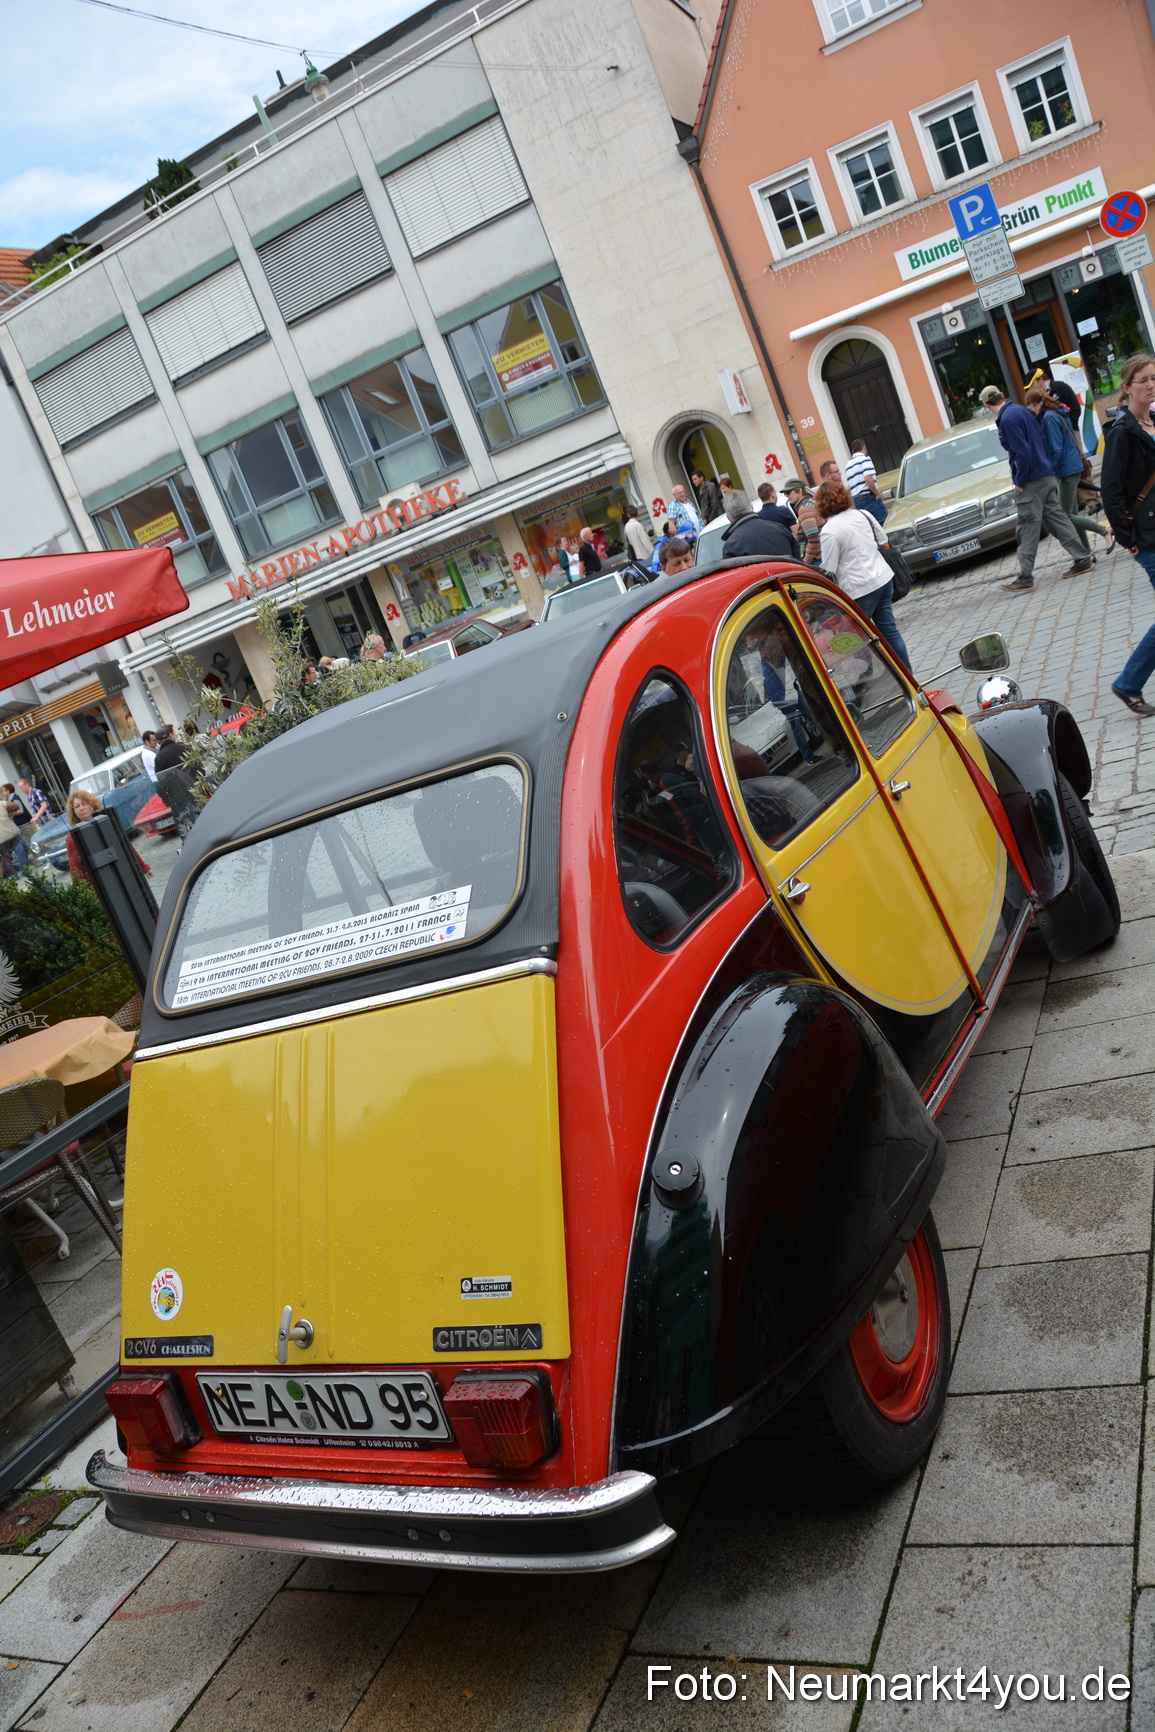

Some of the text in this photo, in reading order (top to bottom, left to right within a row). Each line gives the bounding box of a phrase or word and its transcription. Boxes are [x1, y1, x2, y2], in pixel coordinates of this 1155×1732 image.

[958, 195, 984, 232] P
[999, 203, 1041, 233] Grün
[1044, 179, 1096, 214] Punkt
[969, 239, 1005, 258] Parkschein
[972, 234, 998, 249] nur mit
[973, 260, 991, 273] Mo-Fr
[974, 247, 1004, 263] werktags
[495, 337, 545, 365] ZU VERMIETEN
[800, 416, 815, 429] 39
[145, 515, 174, 533] VERMIETEN
[0, 588, 115, 638] Lehmeier
[204, 951, 247, 968] INTERNATIONAL
[247, 943, 273, 955] MEETING
[274, 941, 283, 949] OF
[369, 909, 399, 923] ALCAÑIZ
[400, 903, 421, 915] SPAIN
[206, 963, 259, 982] INTERNATIONAL
[259, 954, 291, 968] MEETING
[292, 951, 303, 961] OF
[417, 912, 452, 929] FRANCE
[190, 983, 238, 1001] INTERNATIONAL
[238, 974, 266, 989] MEETING
[267, 973, 279, 983] OF
[279, 969, 293, 980] 2CV
[375, 943, 399, 957] CZECH
[399, 933, 436, 950] REPUBLIC
[436, 1325, 519, 1348] CITROËN
[161, 1344, 211, 1355] CHARLESTON
[378, 1382, 440, 1431] 95
[255, 1435, 278, 1444] Citroën
[277, 1436, 294, 1444] Heinz
[294, 1437, 320, 1446] Schmidt
[323, 1438, 357, 1447] Uffenheim
